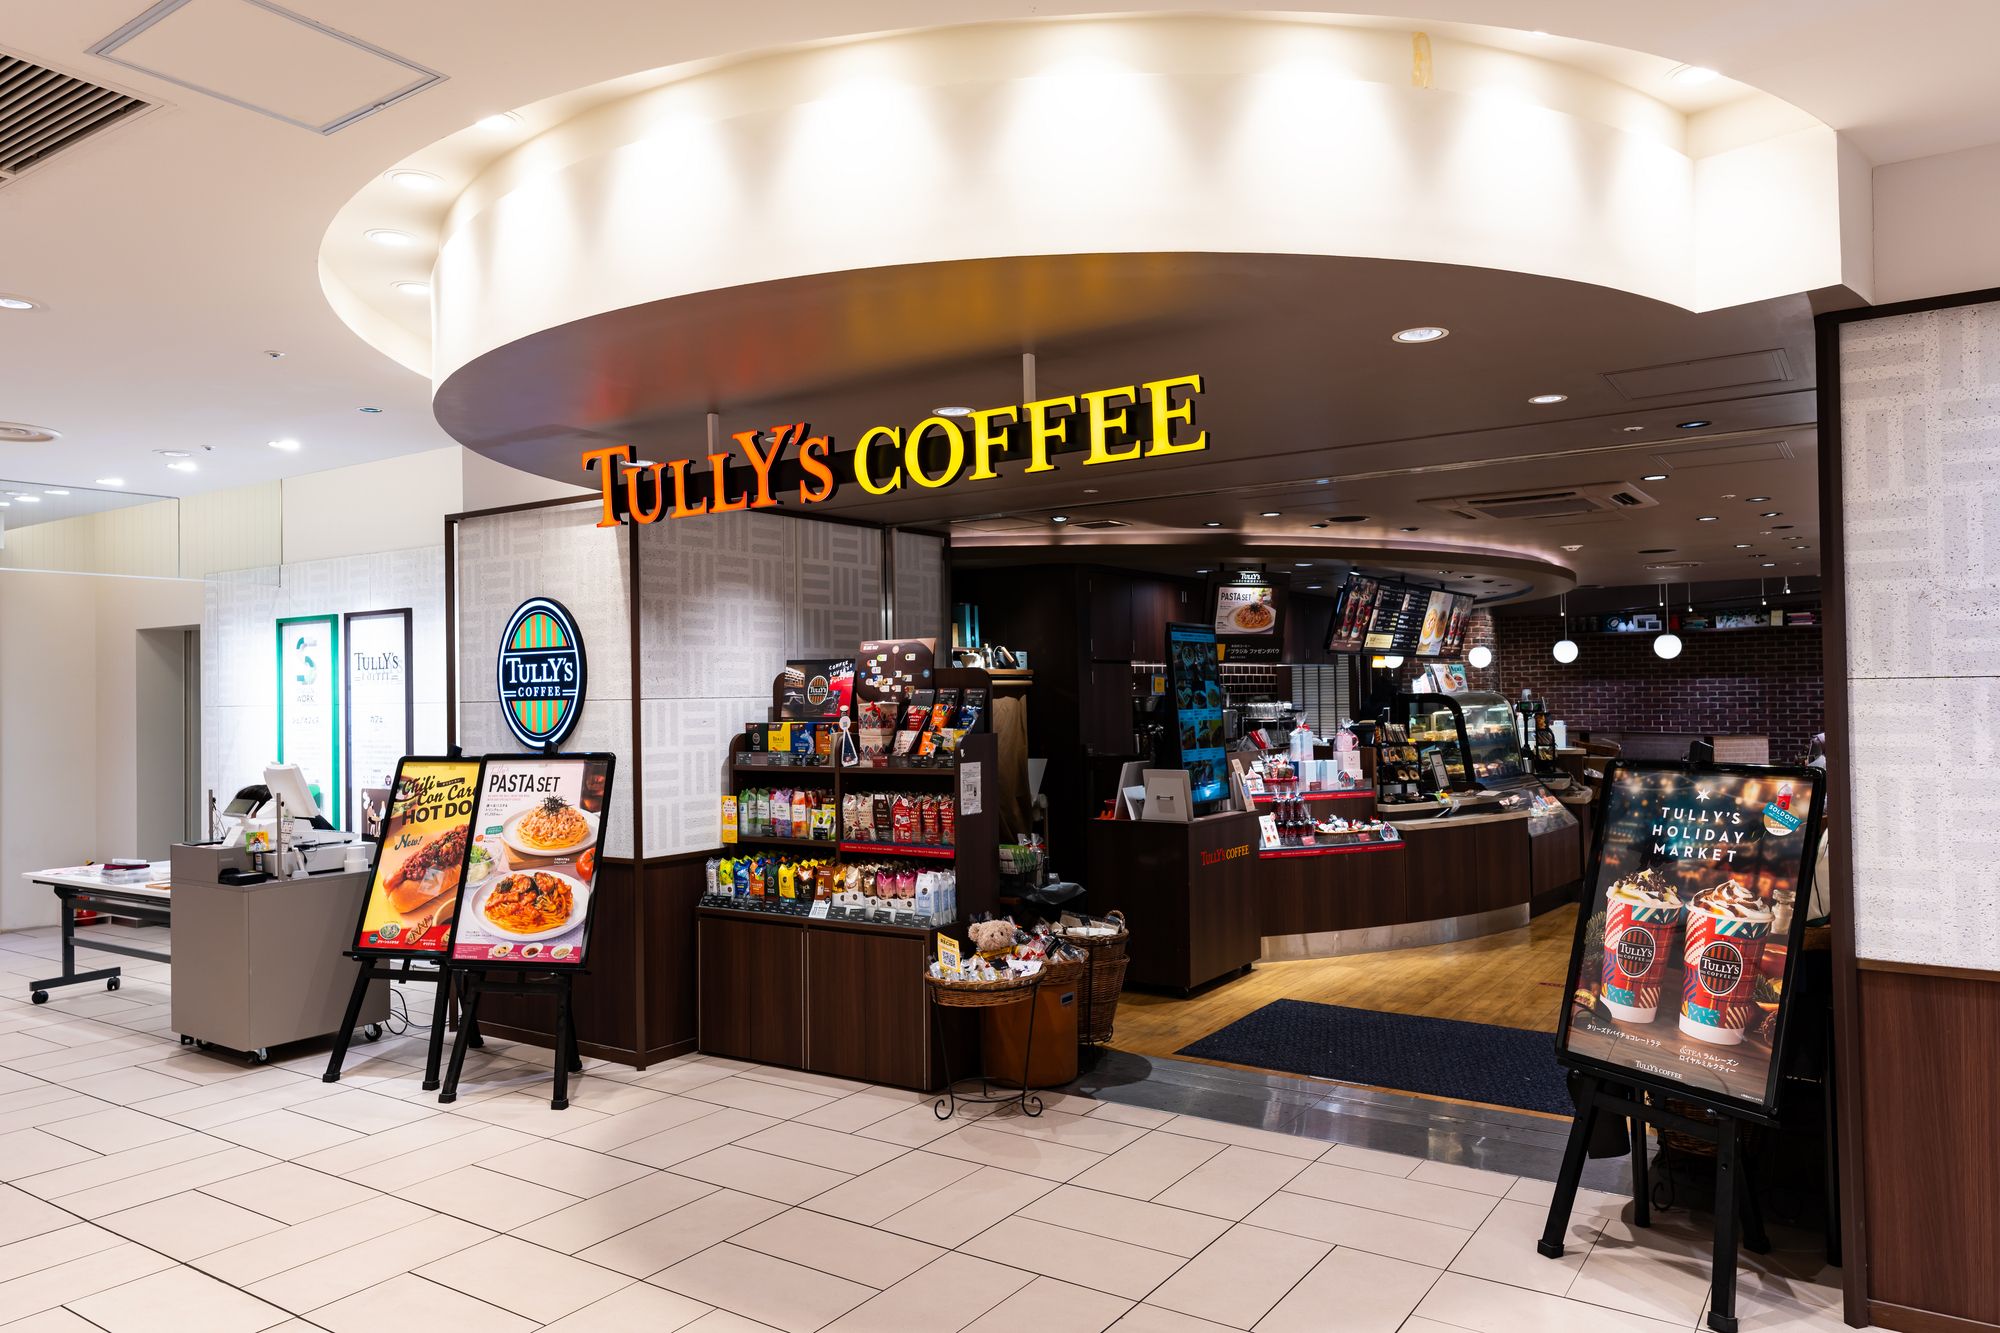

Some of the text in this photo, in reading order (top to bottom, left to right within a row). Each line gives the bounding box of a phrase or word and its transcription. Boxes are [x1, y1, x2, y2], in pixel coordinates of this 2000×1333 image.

[582, 374, 1210, 528] TULLY'S COFFEE
[1220, 592, 1252, 601] PASTA SET
[354, 652, 399, 671] TULLY'S
[505, 657, 574, 684] TULLY'S
[517, 686, 561, 697] COFFEE
[400, 775, 436, 799] Chili
[488, 774, 561, 793] PASTA SET
[417, 785, 476, 806] Con Car
[402, 799, 473, 826] HOT DO
[1661, 806, 1741, 825] TULLY'S
[1768, 804, 1798, 824] SOLD OUT
[394, 833, 423, 851] New!
[1652, 824, 1744, 844] HOLIDAY
[1200, 844, 1249, 866] TULLY'S COFFEE
[1653, 843, 1737, 863] MARKET
[1619, 942, 1653, 957] TULLY'S
[1623, 954, 1645, 962] COFFEE
[1702, 958, 1740, 975] TULLY'S
[1706, 971, 1731, 979] COFFEE
[1679, 1045, 1739, 1067] &TEA ラムレーズン
[1679, 1055, 1736, 1073] ロイヤルミルクティー
[1635, 1059, 1683, 1080] TULLY'S COFFEE
